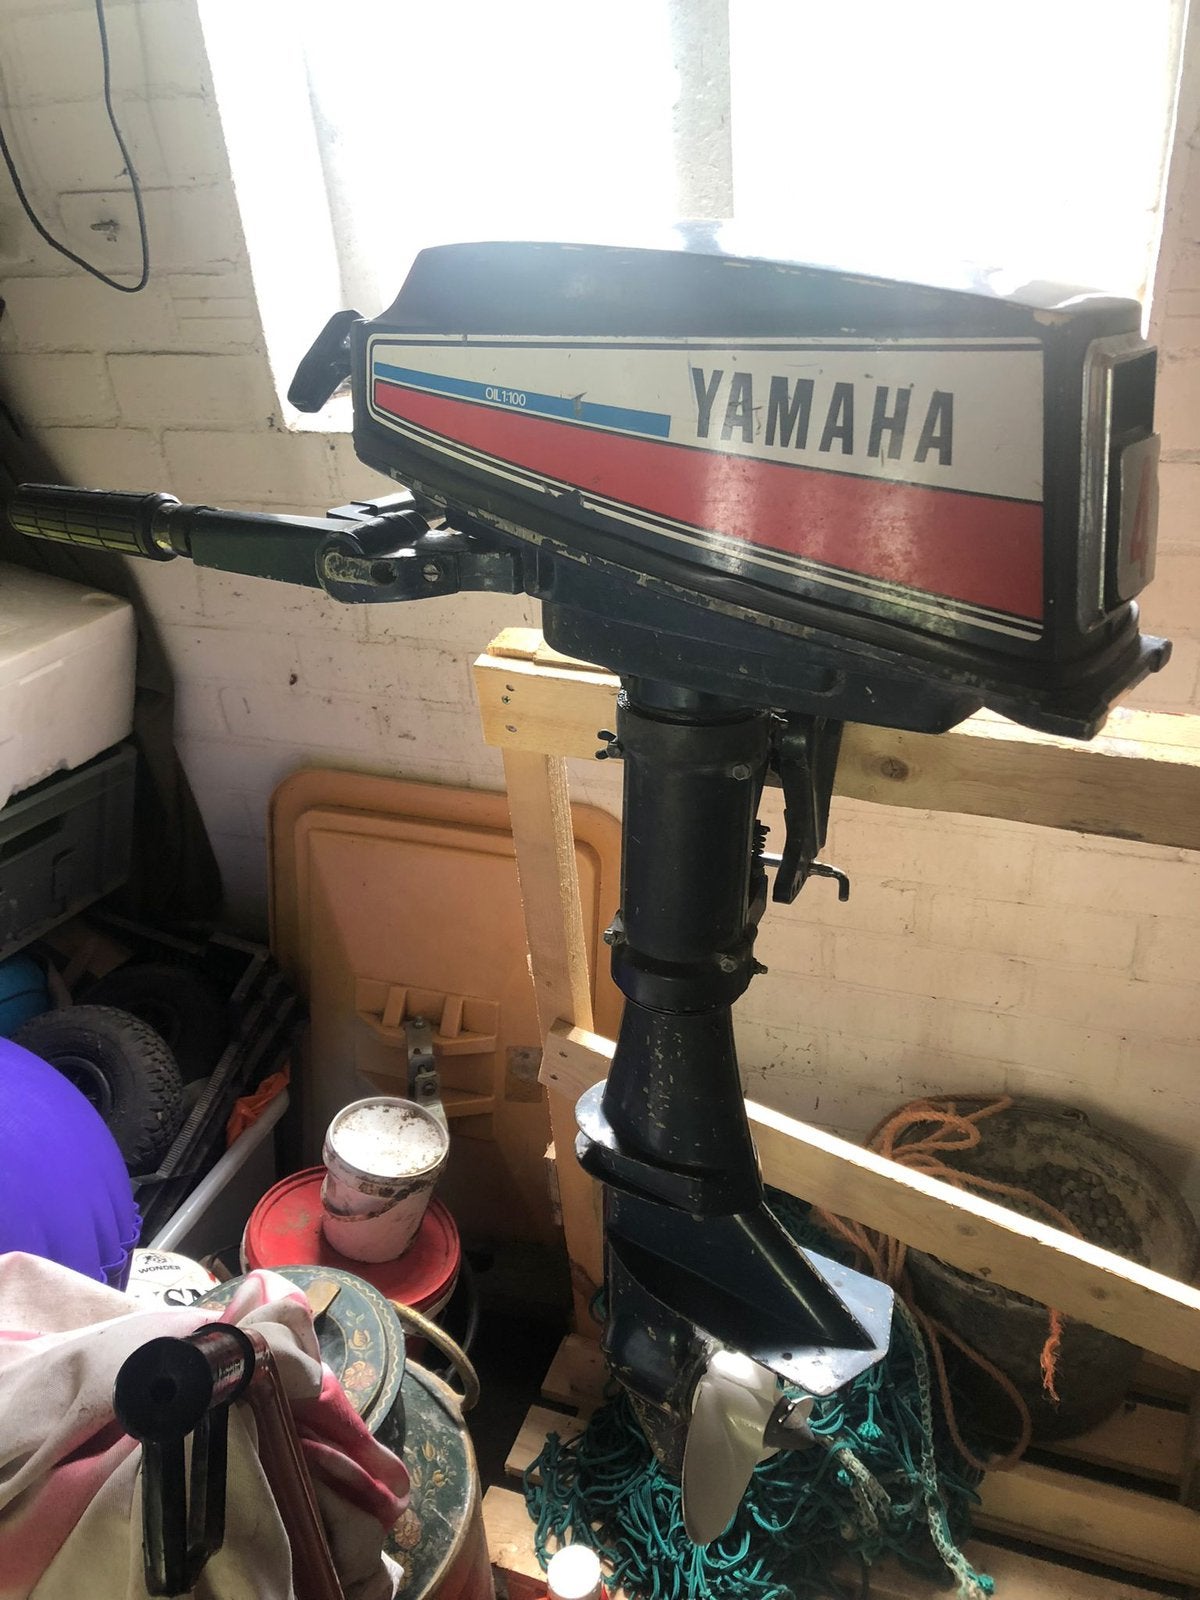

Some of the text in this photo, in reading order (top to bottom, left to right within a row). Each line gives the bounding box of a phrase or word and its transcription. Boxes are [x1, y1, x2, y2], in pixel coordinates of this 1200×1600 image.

[691, 367, 954, 466] YAMAHA
[1129, 456, 1150, 578] 4
[138, 1265, 181, 1274] WONDER
